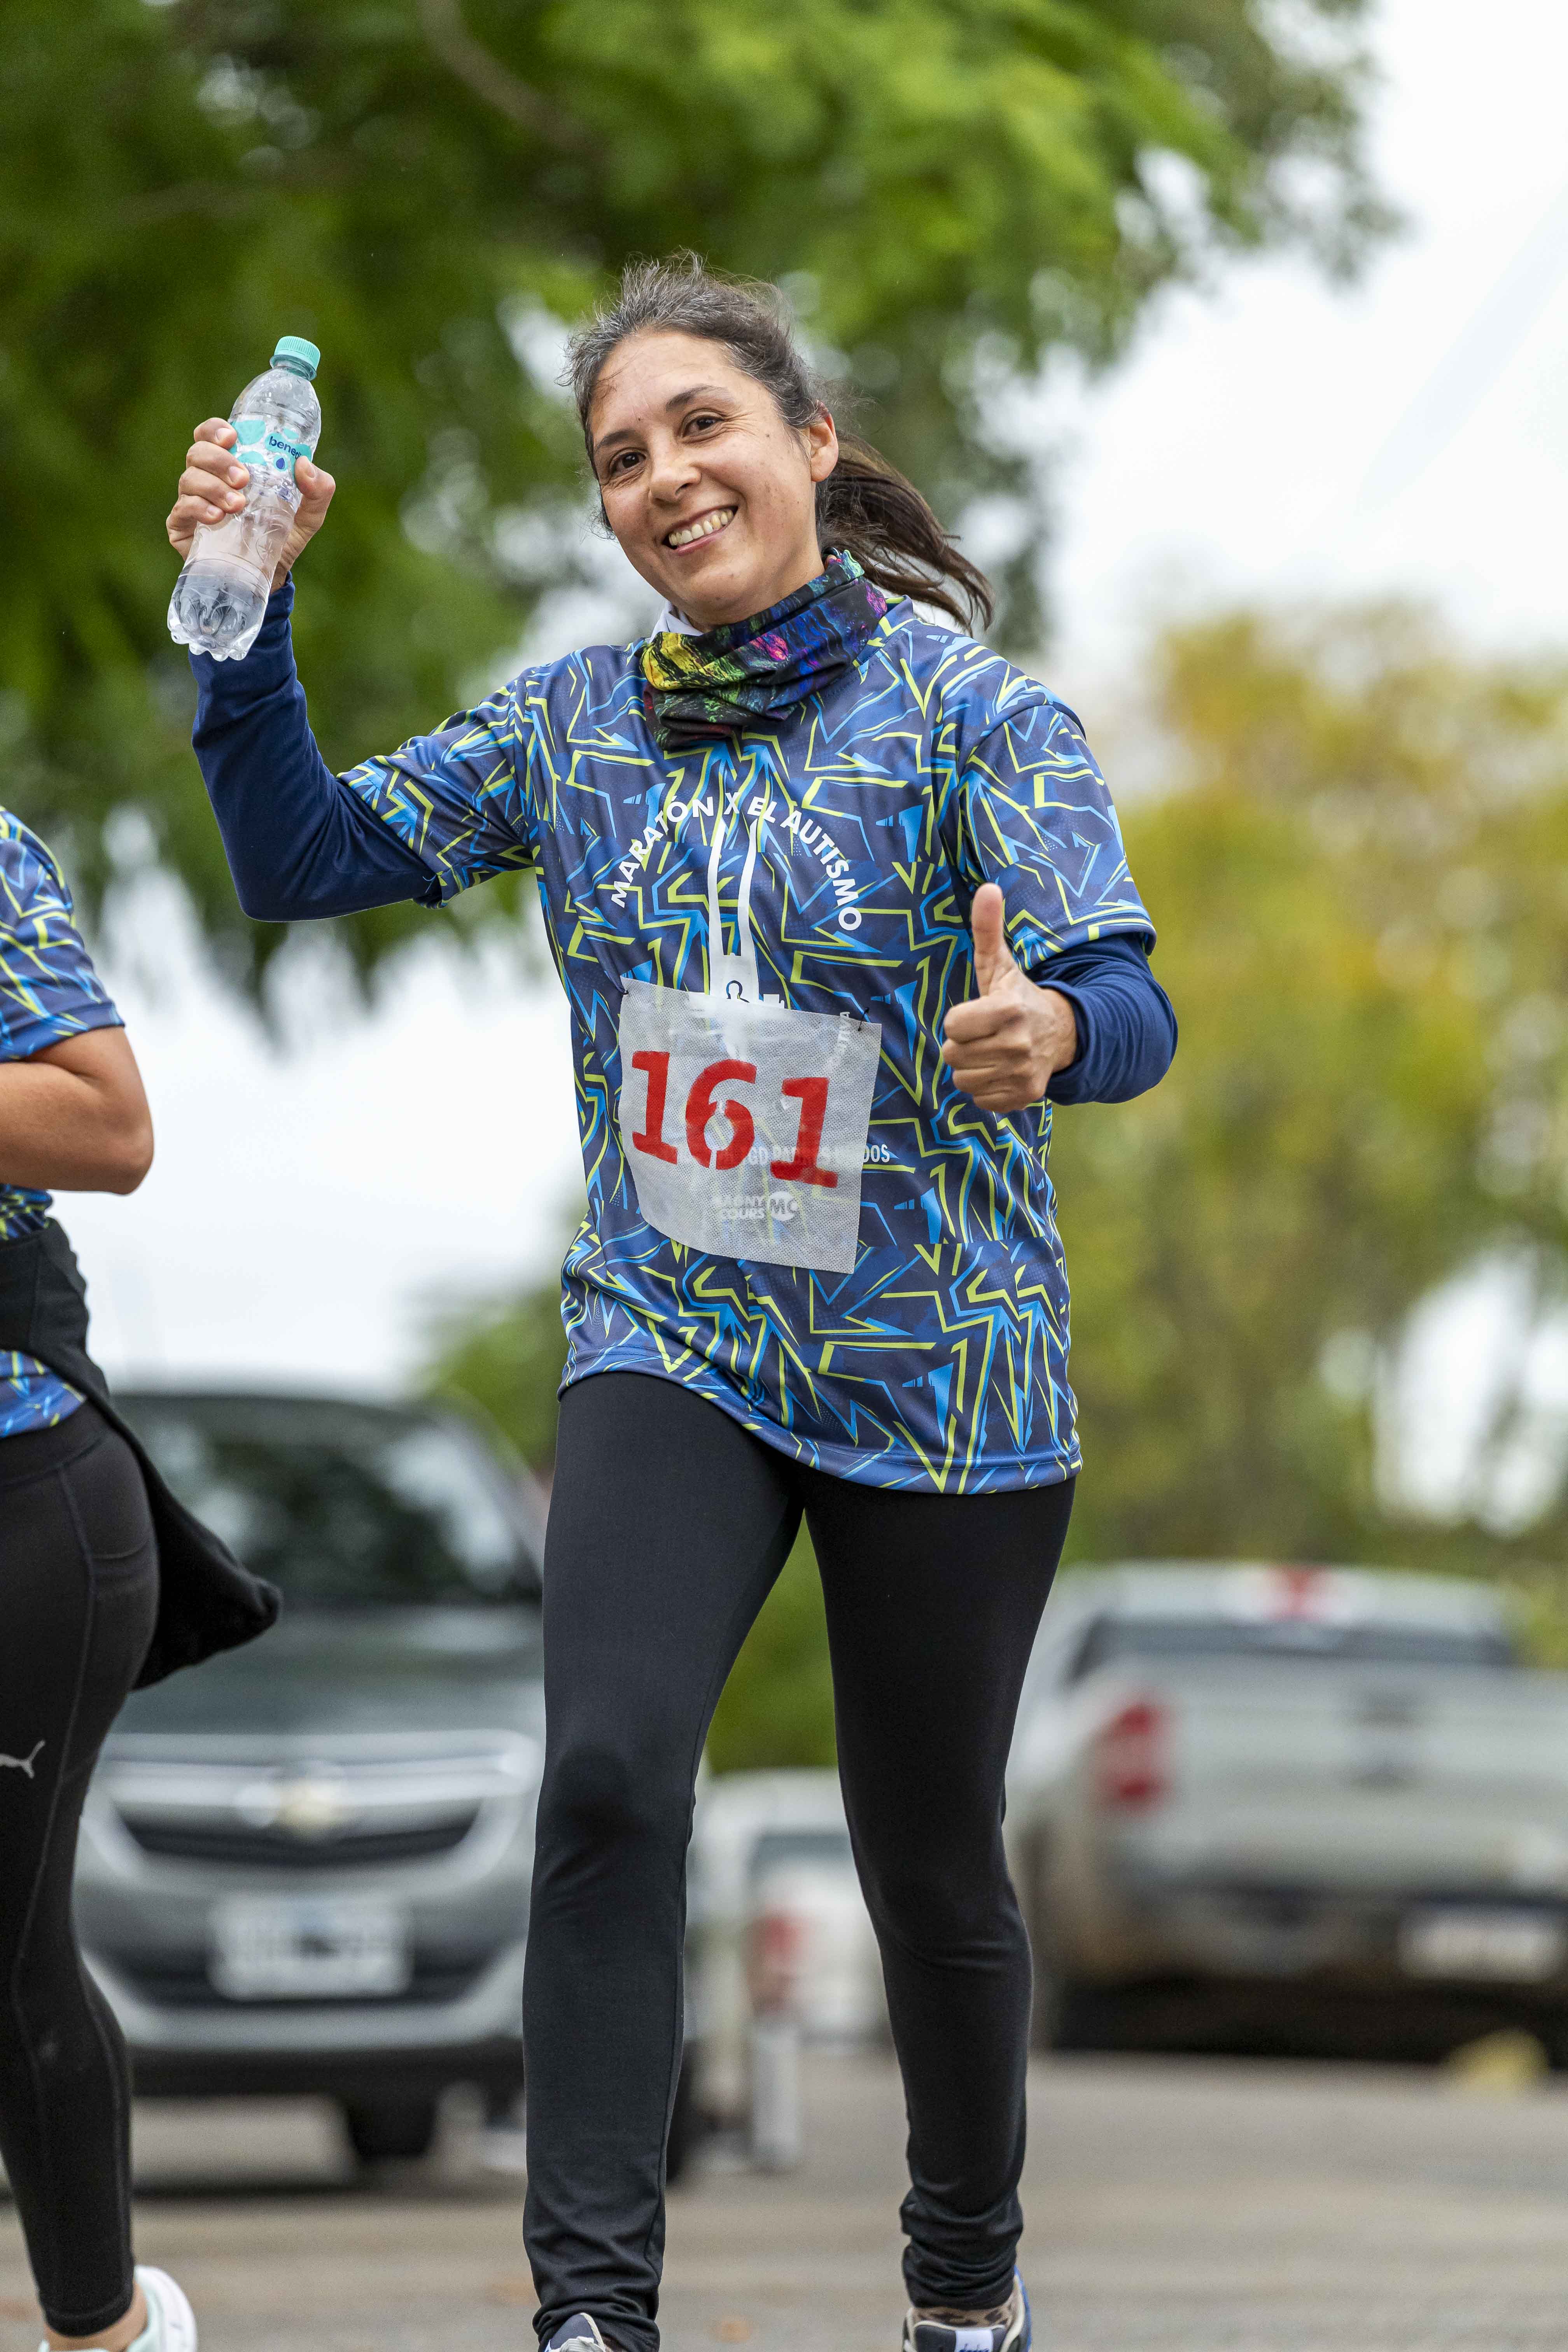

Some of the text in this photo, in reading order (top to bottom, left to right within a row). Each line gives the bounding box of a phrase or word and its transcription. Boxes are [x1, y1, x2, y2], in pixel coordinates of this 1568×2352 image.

[611, 792, 862, 931] MARATÓN X EL AUTISMO
[632, 1050, 838, 1188] 161
